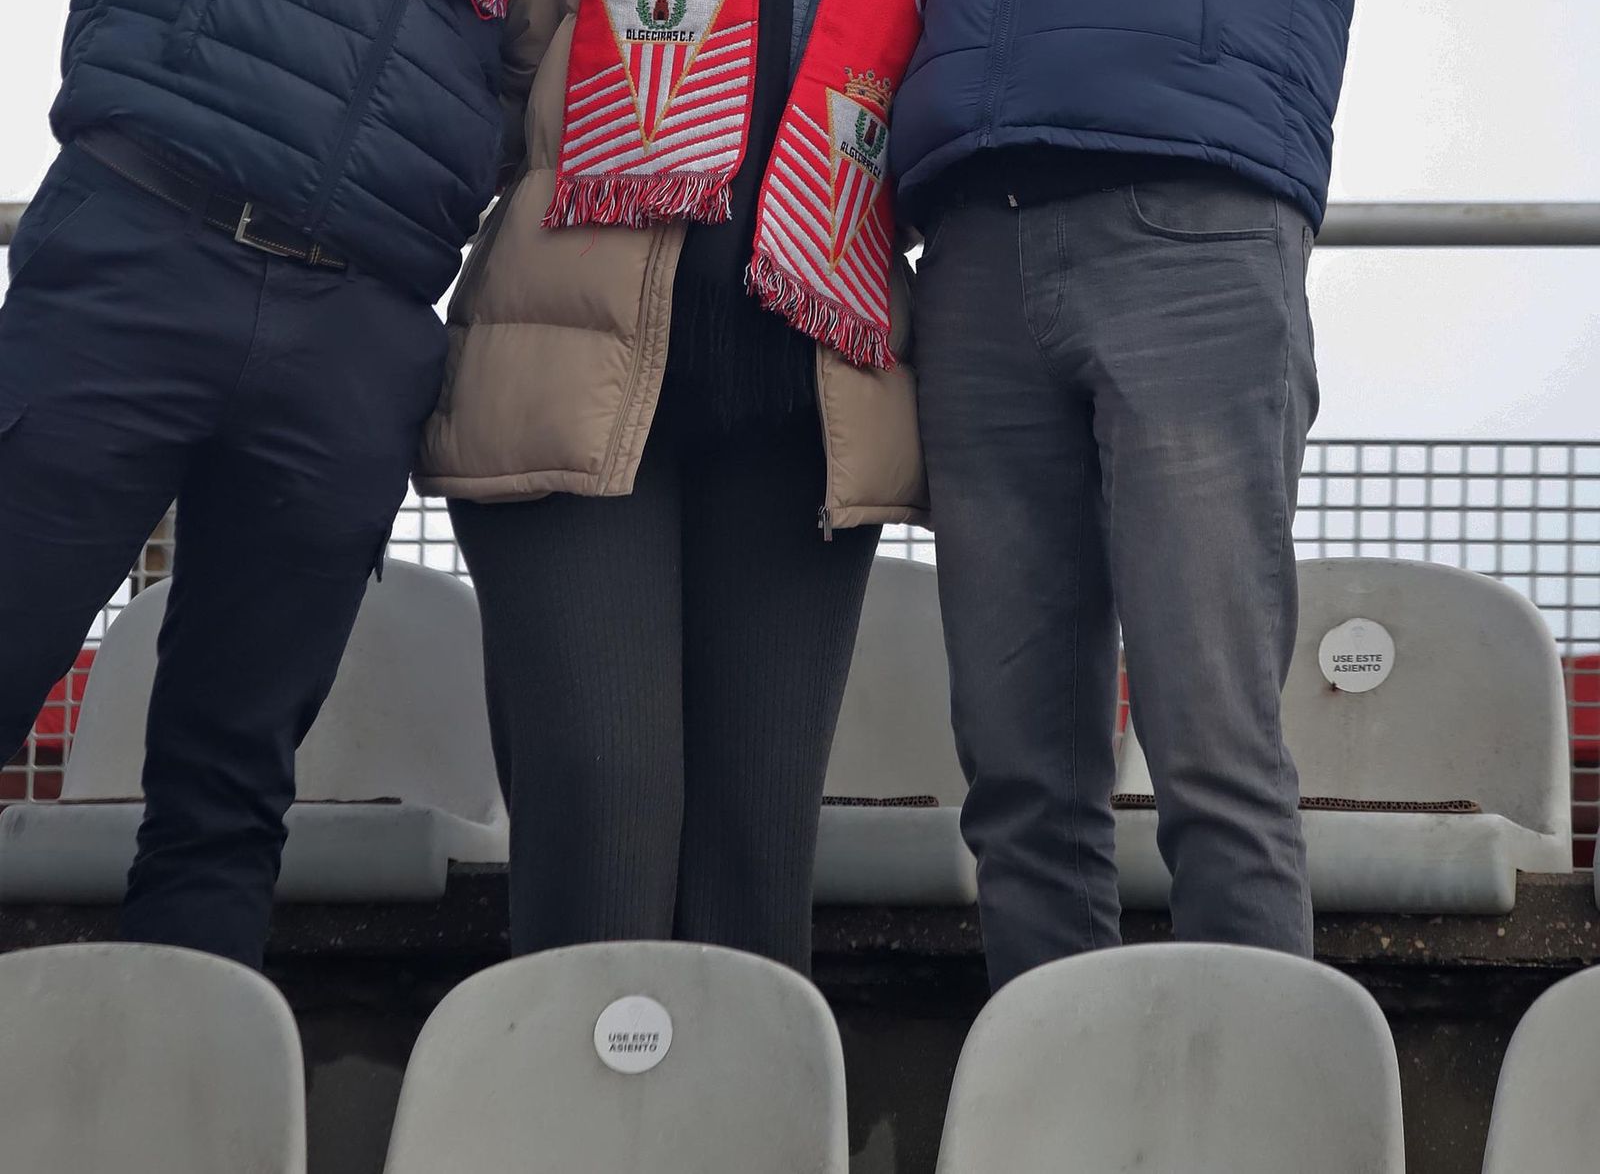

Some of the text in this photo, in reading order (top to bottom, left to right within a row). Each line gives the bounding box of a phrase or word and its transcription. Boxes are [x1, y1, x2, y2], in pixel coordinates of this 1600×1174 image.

[1332, 654, 1382, 663] USE ESTE
[1334, 664, 1381, 672] ASIENTO
[608, 1033, 659, 1042] USE ESTE
[609, 1044, 658, 1052] ASIENTO
